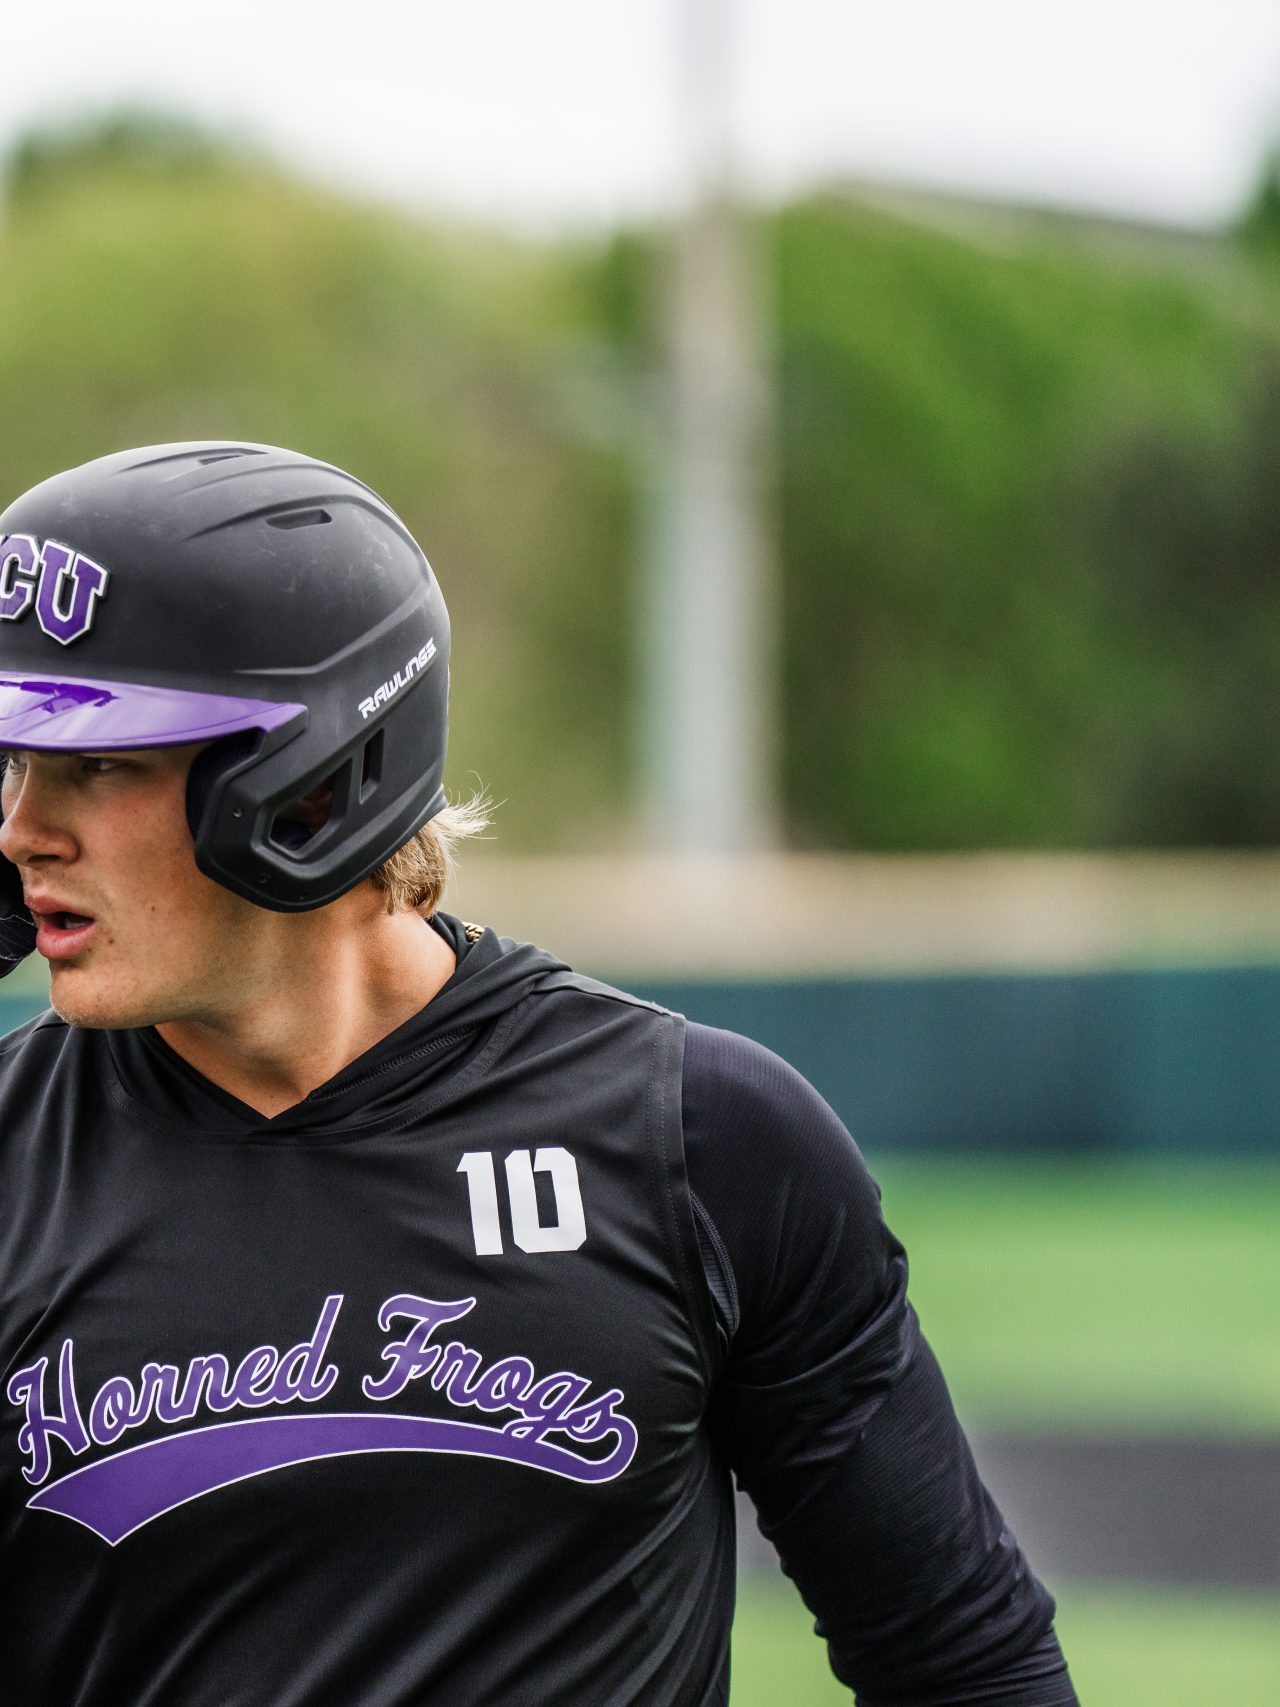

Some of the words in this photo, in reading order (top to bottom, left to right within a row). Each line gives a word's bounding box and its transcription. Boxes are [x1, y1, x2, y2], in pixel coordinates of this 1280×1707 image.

[358, 636, 437, 720] RAWLINGS
[455, 1147, 587, 1256] 10
[7, 1294, 344, 1485] Horned
[362, 1294, 628, 1446] Frogs
